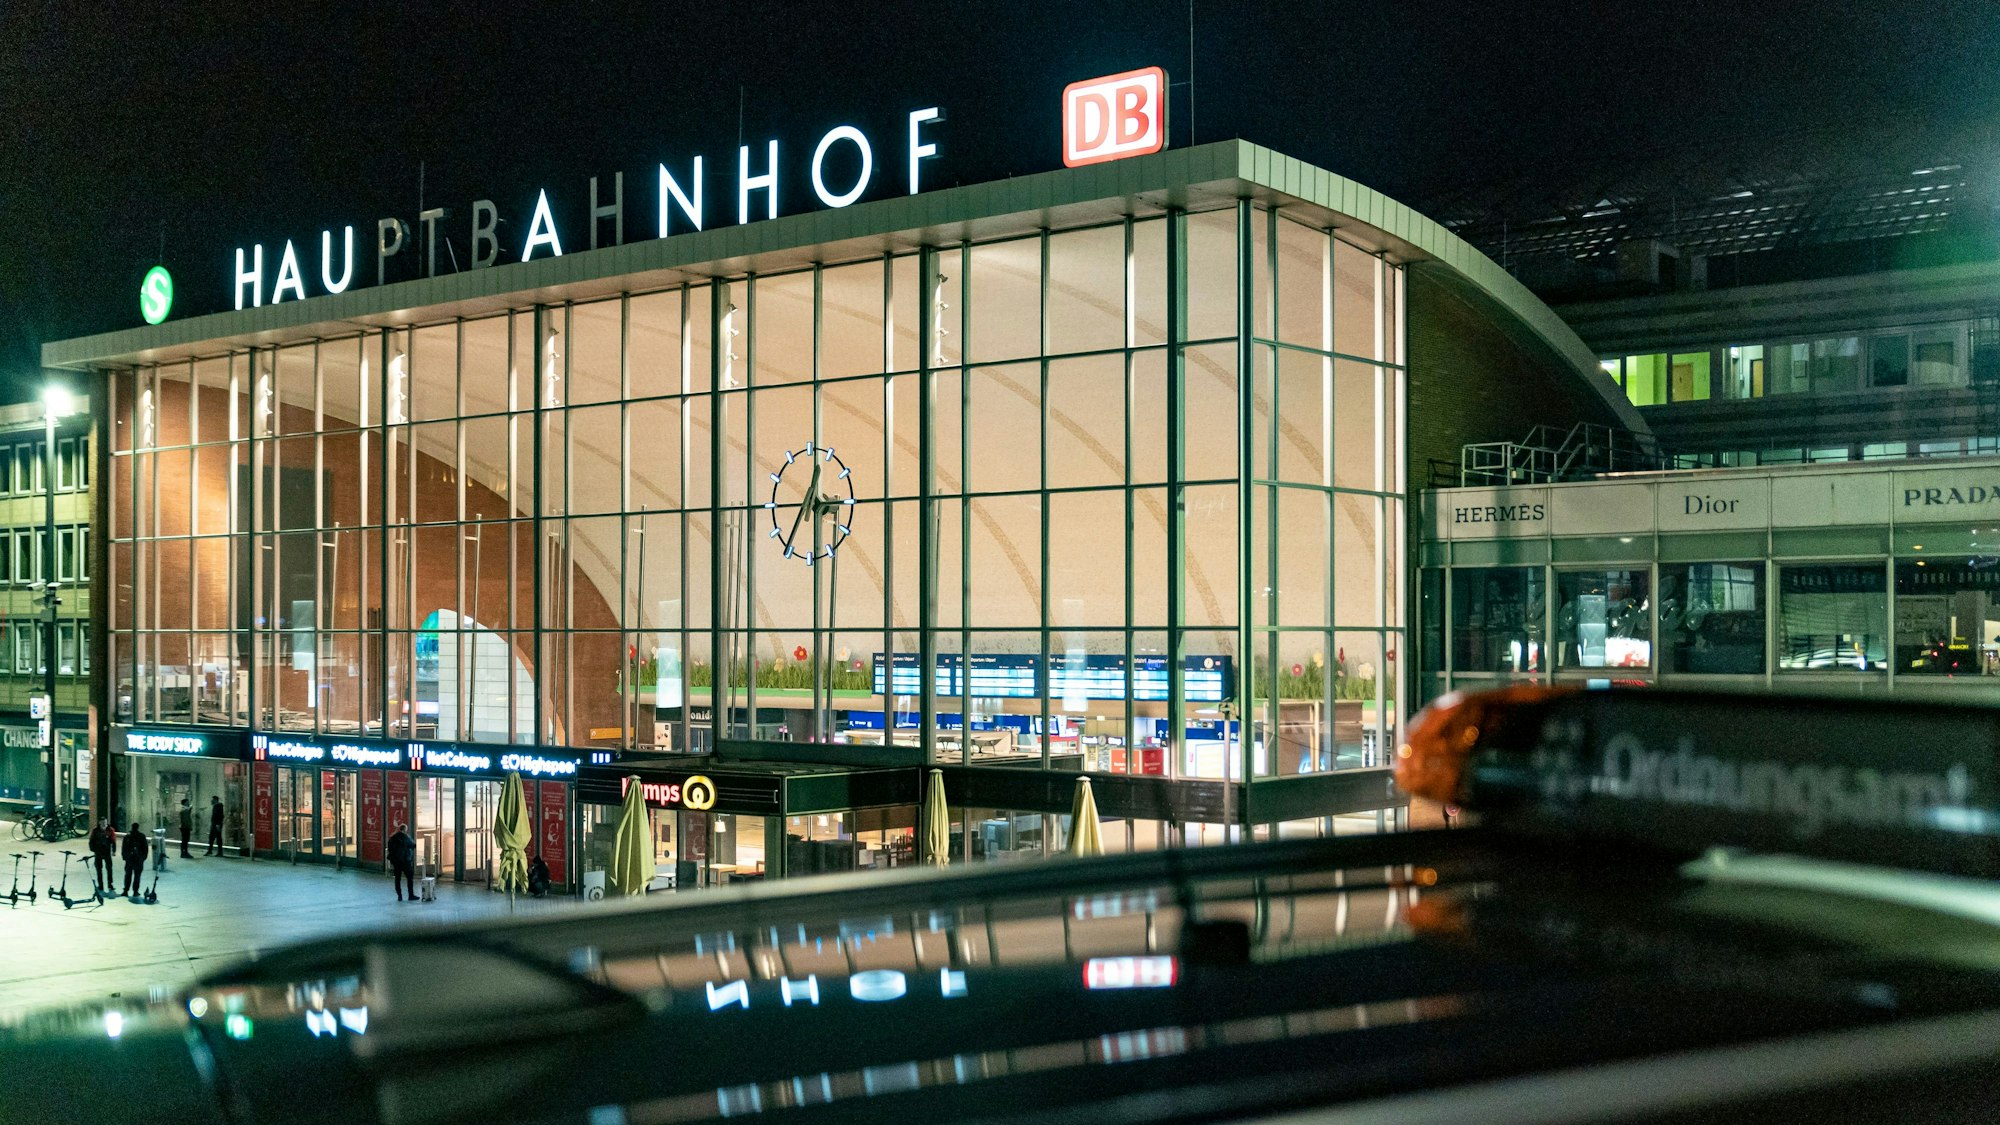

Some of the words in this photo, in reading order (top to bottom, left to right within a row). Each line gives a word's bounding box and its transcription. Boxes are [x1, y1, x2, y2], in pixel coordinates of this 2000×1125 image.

[1076, 84, 1149, 152] DB
[234, 106, 943, 311] HAUPTBAHNHOF
[144, 272, 168, 319] S
[1683, 495, 1740, 515] Dior
[1904, 485, 2000, 506] PRADA
[1455, 503, 1545, 523] HERMÈS
[127, 734, 147, 750] THE
[147, 735, 175, 751] BODY
[175, 736, 203, 753] SHOP
[268, 741, 323, 761] NetCologne
[347, 745, 399, 765] Highspeed
[426, 750, 490, 772] NetCologne
[1603, 732, 1970, 838] Ordnungsamt
